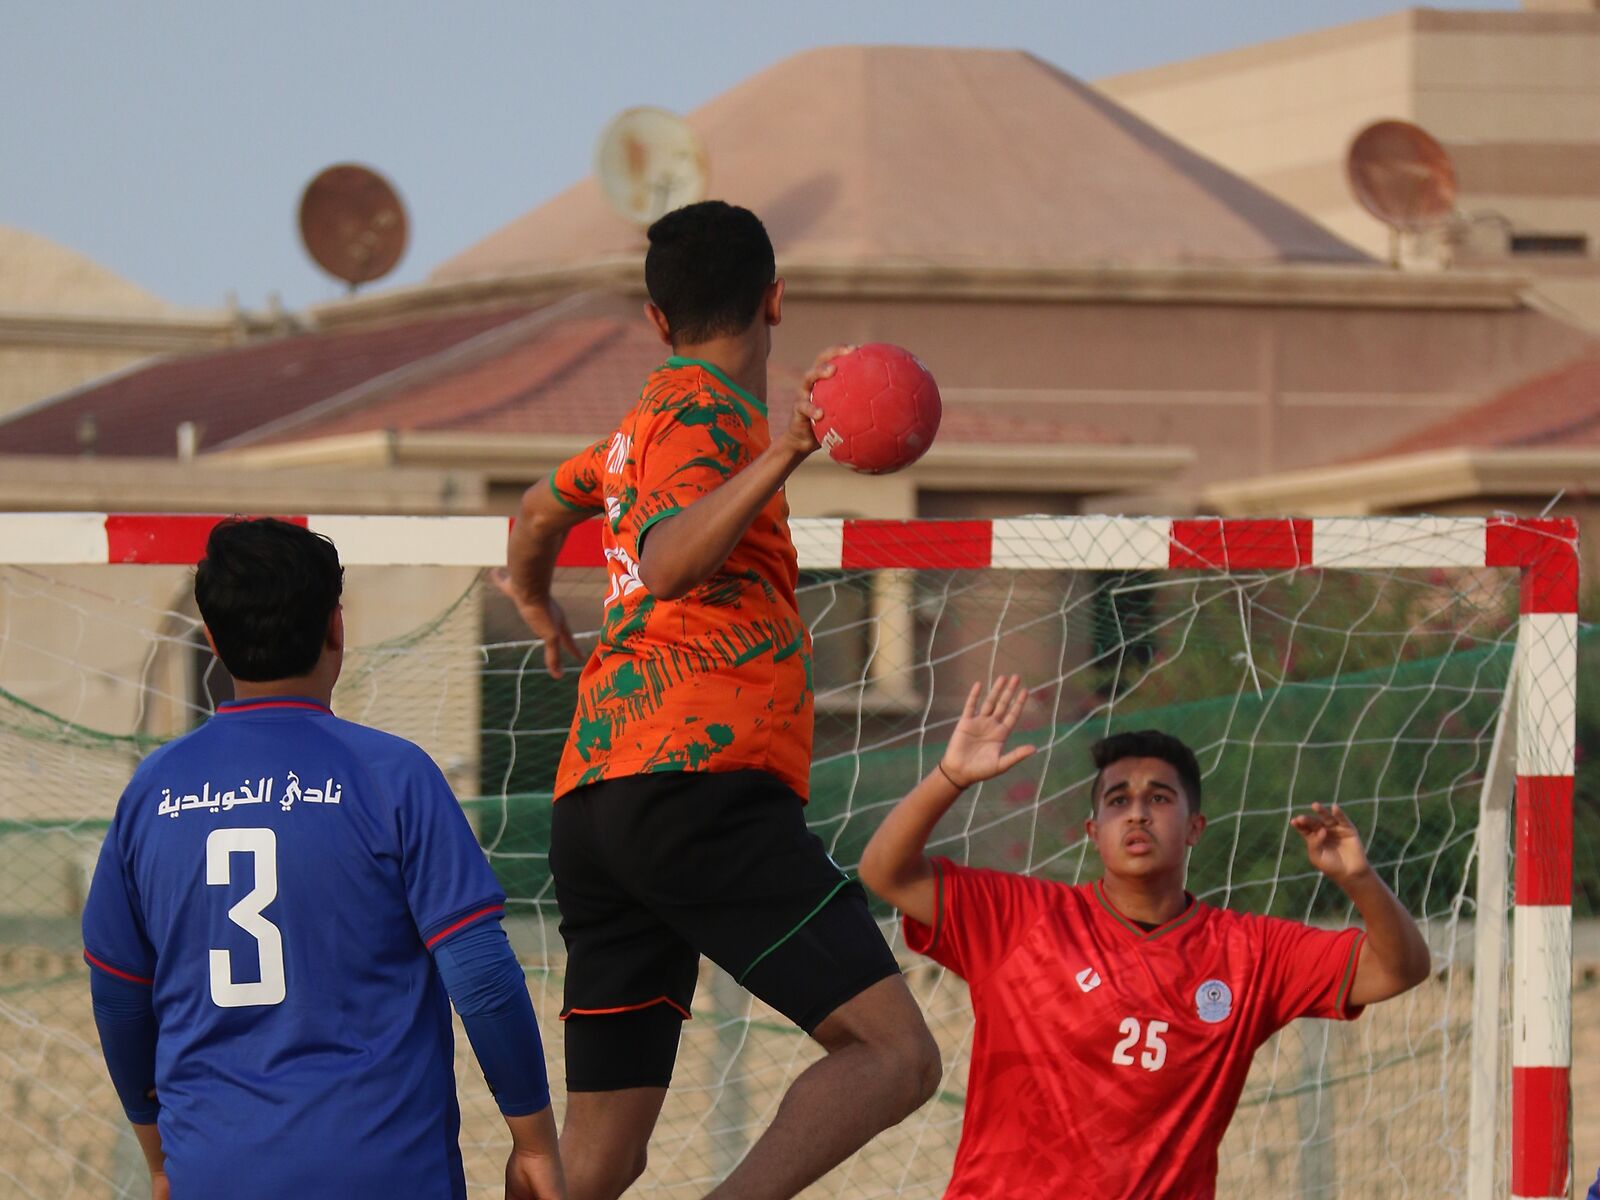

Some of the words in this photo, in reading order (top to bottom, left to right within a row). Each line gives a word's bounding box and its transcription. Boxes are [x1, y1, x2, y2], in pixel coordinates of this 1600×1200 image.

[157, 777, 273, 818] الخويلدية
[279, 771, 342, 811] نادي
[206, 828, 286, 1008] 3
[1112, 1017, 1169, 1072] 25
